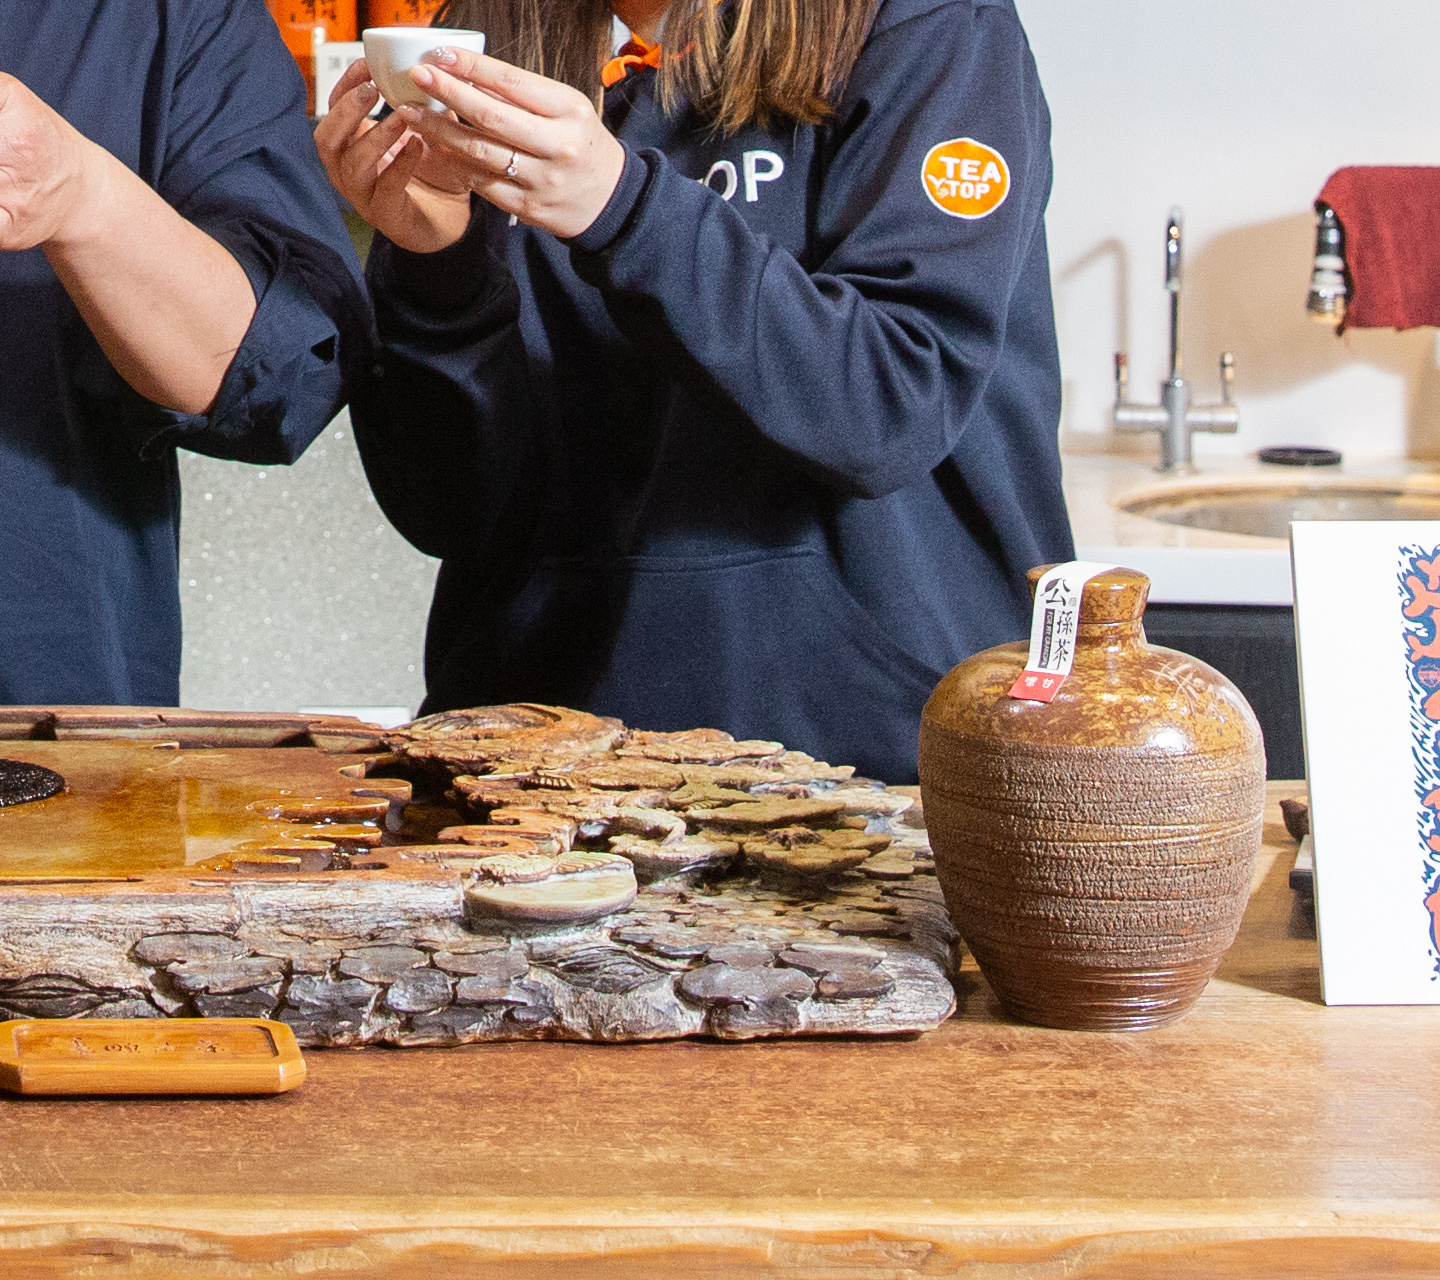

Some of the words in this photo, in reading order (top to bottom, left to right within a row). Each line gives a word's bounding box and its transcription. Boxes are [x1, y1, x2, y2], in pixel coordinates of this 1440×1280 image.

[698, 148, 785, 203] OP
[938, 155, 1002, 184] TEA
[1040, 578, 1074, 664] 公孫茶
